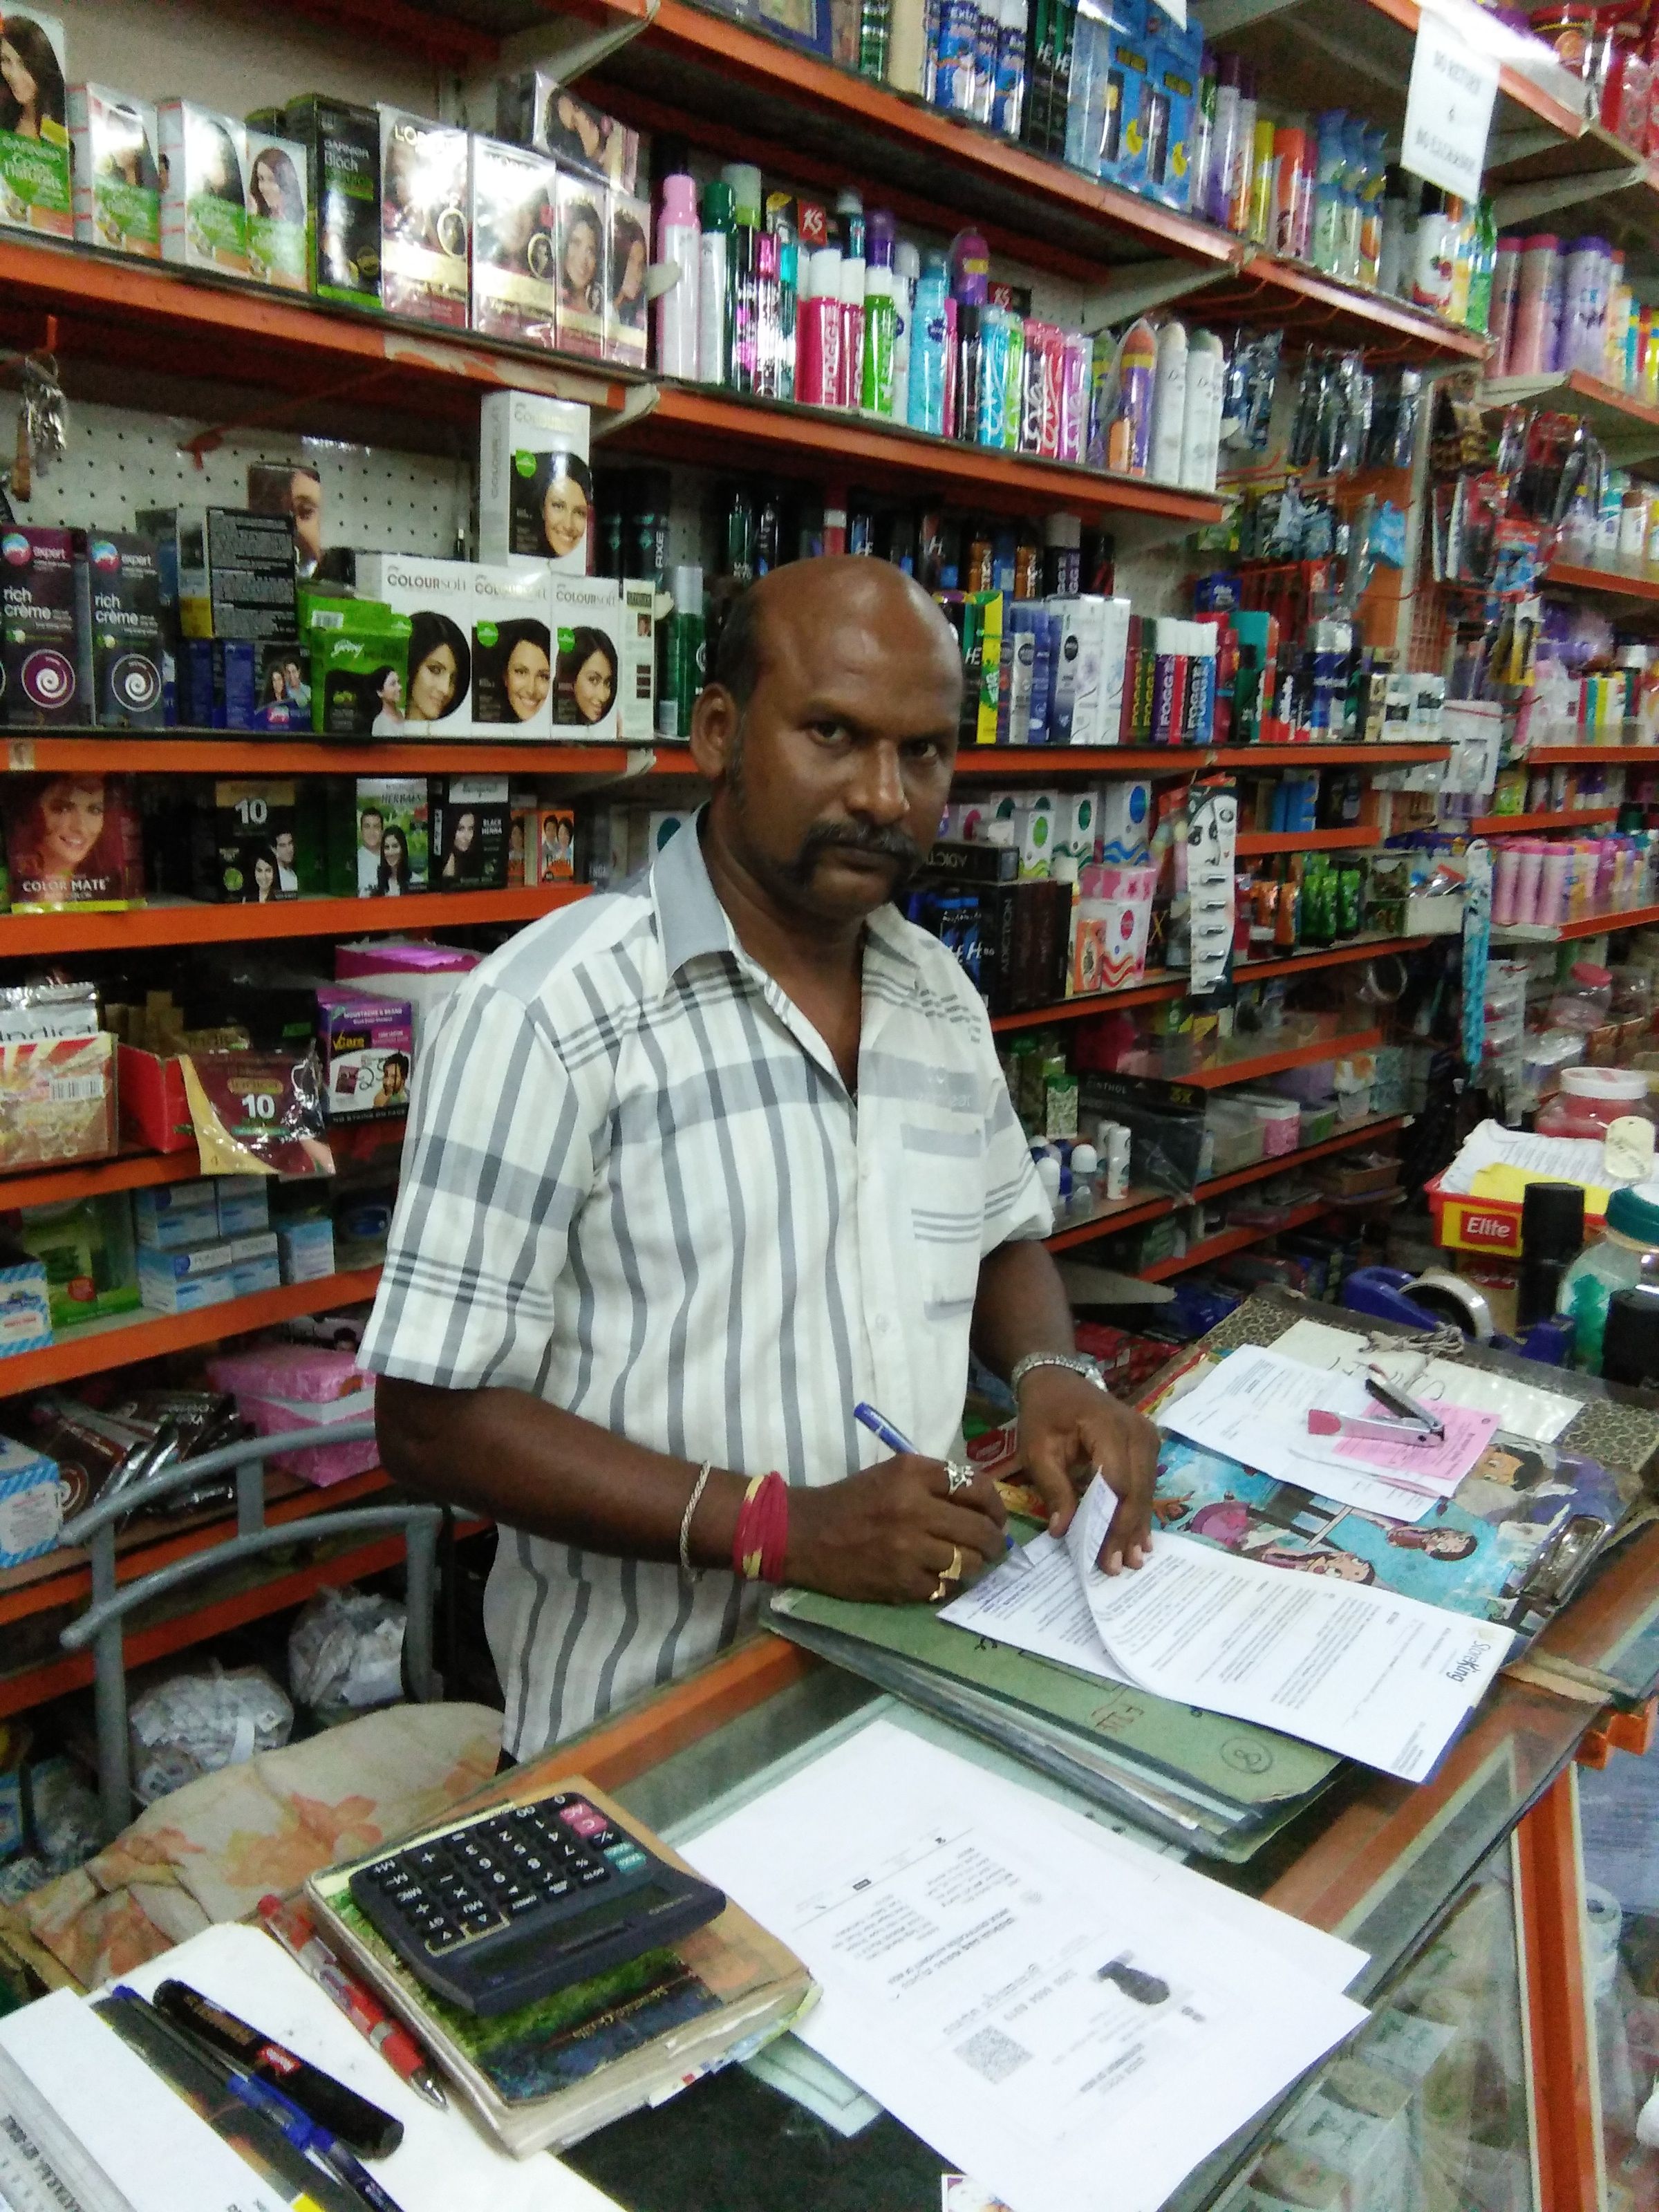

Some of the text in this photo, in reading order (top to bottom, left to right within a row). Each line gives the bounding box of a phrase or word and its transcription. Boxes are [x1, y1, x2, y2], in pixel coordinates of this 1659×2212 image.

[655, 531, 664, 569] AXE
[3, 585, 32, 603] rich
[234, 797, 268, 825] 10
[71, 878, 106, 892] MATE
[241, 1094, 275, 1119] 10
[1466, 1217, 1511, 1239] Elite
